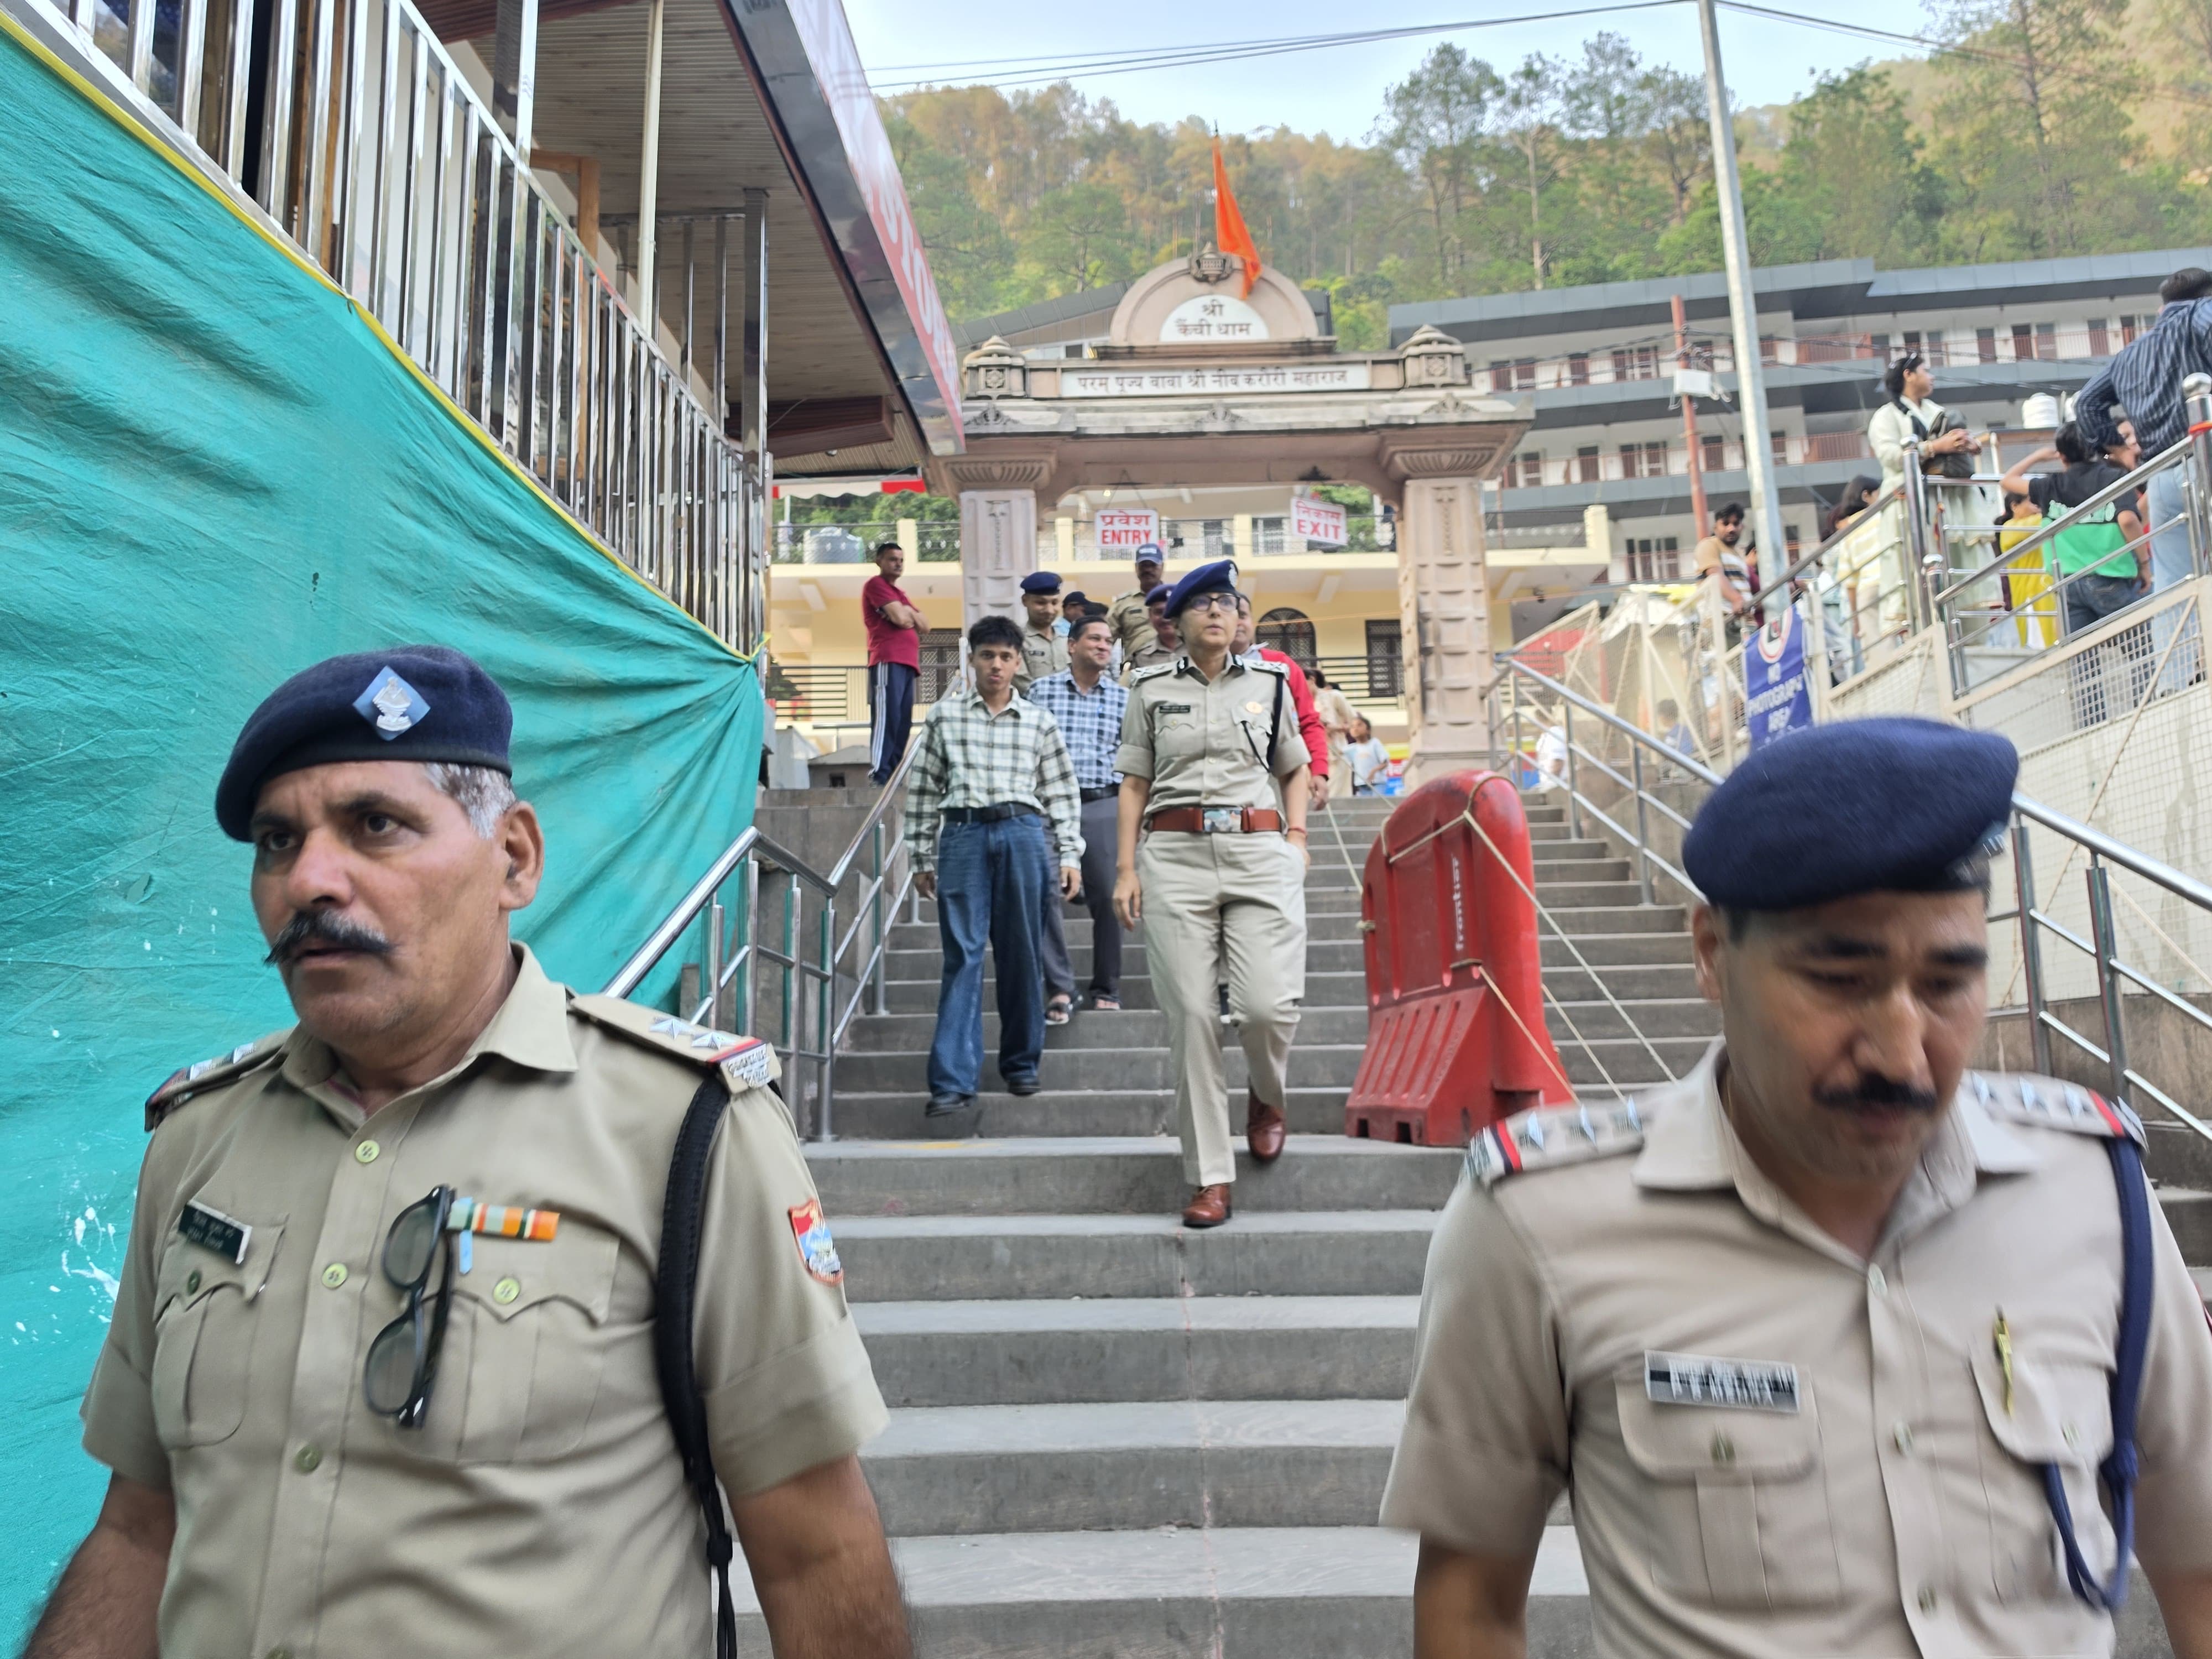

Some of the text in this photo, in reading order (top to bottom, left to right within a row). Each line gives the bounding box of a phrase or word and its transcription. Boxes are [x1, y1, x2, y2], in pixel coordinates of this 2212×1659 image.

[1202, 299, 1224, 316] श्री
[1217, 322, 1251, 336] धाम
[1188, 369, 1206, 388] श्री
[1292, 371, 1347, 387] महाराज
[1100, 510, 1151, 526] प्रवेश
[1102, 530, 1151, 544] ENTRY
[1297, 519, 1341, 540] EXIT
